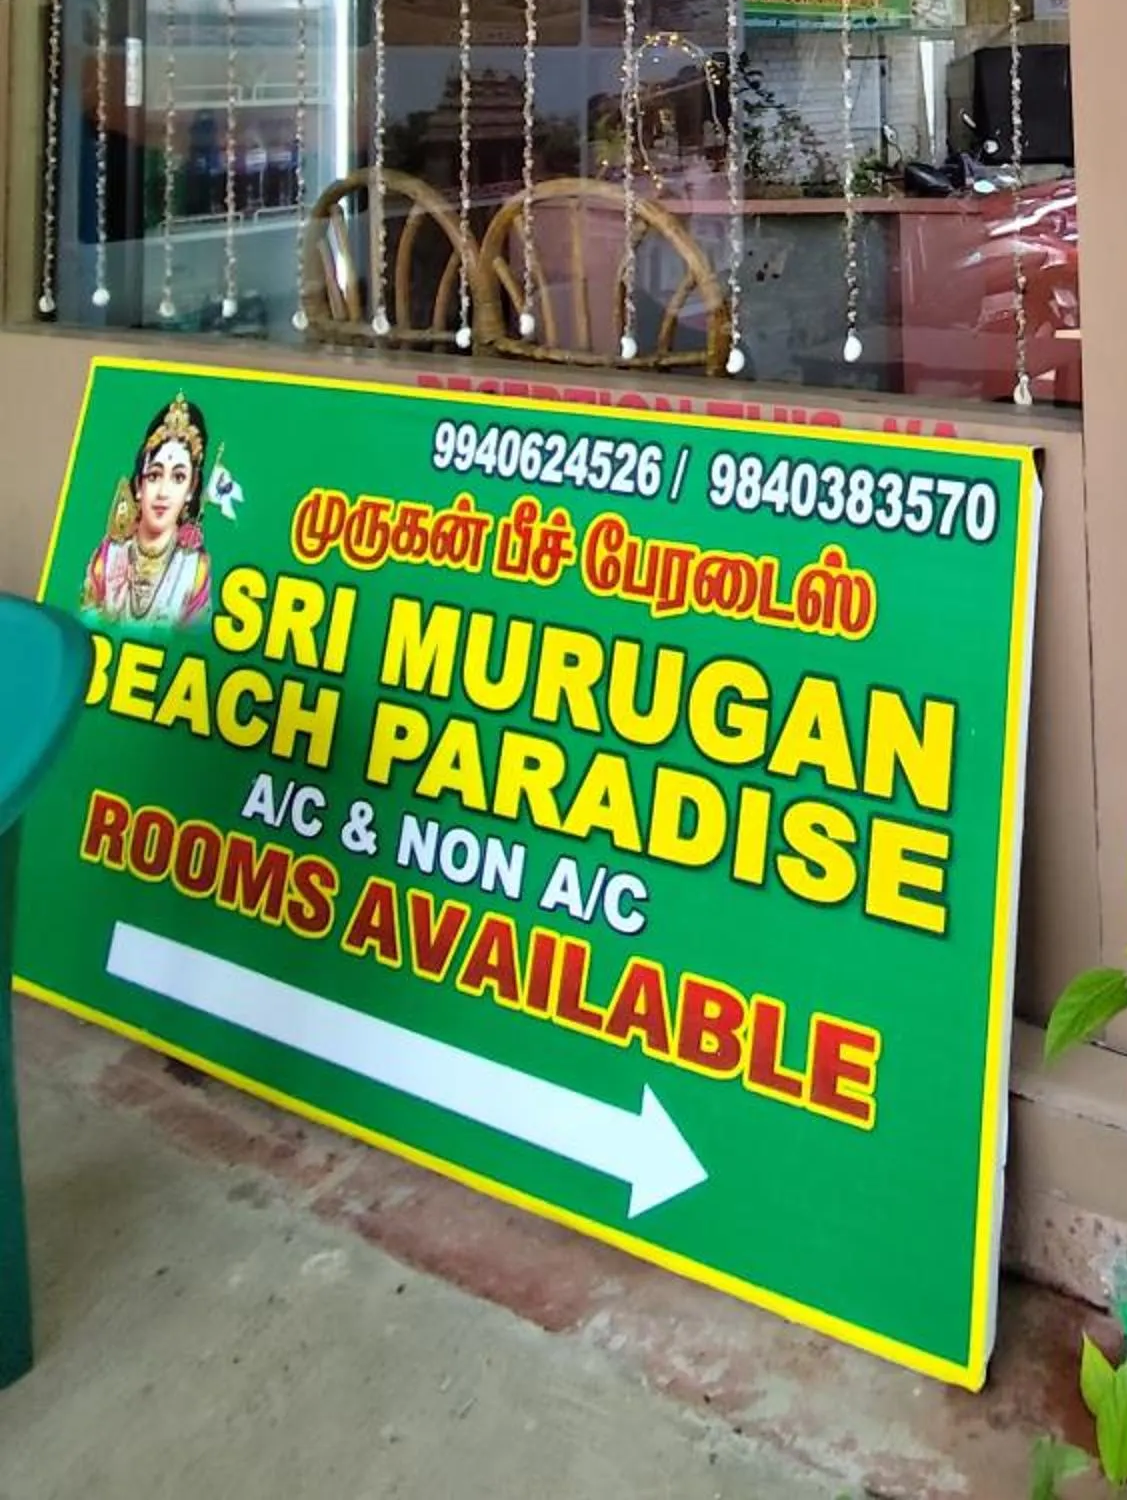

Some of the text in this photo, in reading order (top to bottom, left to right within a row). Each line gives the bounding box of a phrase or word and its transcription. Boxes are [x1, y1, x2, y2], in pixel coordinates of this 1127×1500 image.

[295, 490, 876, 639] முருகன் பீச் பேரடைஸ்
[433, 421, 663, 497] 9940624526
[709, 453, 997, 541] 9840383570
[213, 567, 956, 812] SRI MURUGAN
[240, 773, 650, 934] A/C & NON A/C
[366, 703, 950, 933] PARADISE
[80, 789, 882, 1131] ROOMS AVAILABLE
